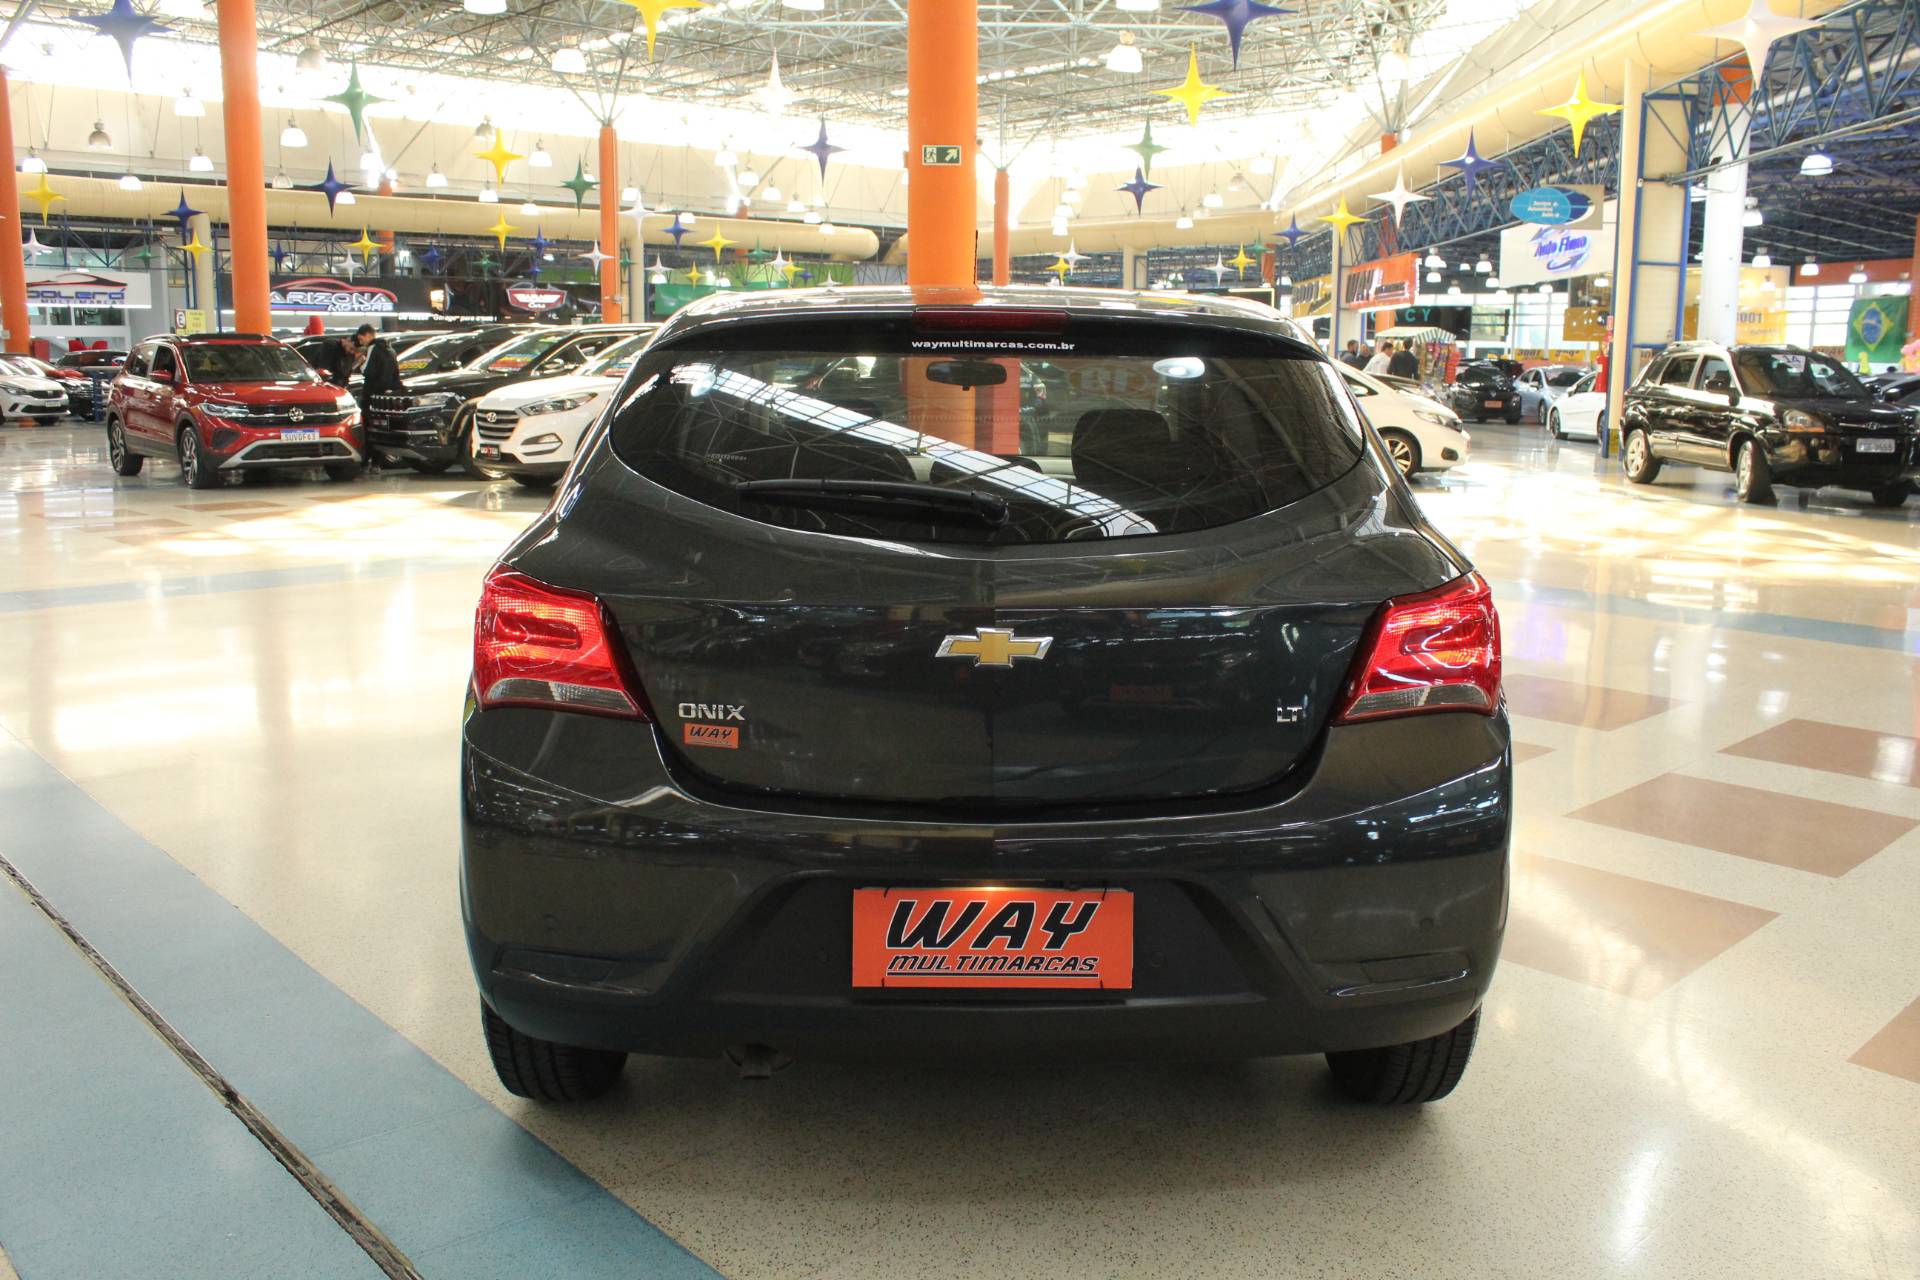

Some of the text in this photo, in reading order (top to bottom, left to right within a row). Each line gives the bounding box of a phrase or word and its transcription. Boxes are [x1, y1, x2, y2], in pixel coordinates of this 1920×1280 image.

[269, 291, 388, 304] ARIZONA
[327, 304, 394, 312] MOTORS
[911, 340, 1075, 350] waymultimarcas.com.br
[678, 702, 745, 720] ONIX
[1276, 706, 1303, 722] LT
[690, 726, 732, 739] WAY
[886, 900, 1101, 950] WAY
[887, 955, 1100, 971] MULTIMARCAS
